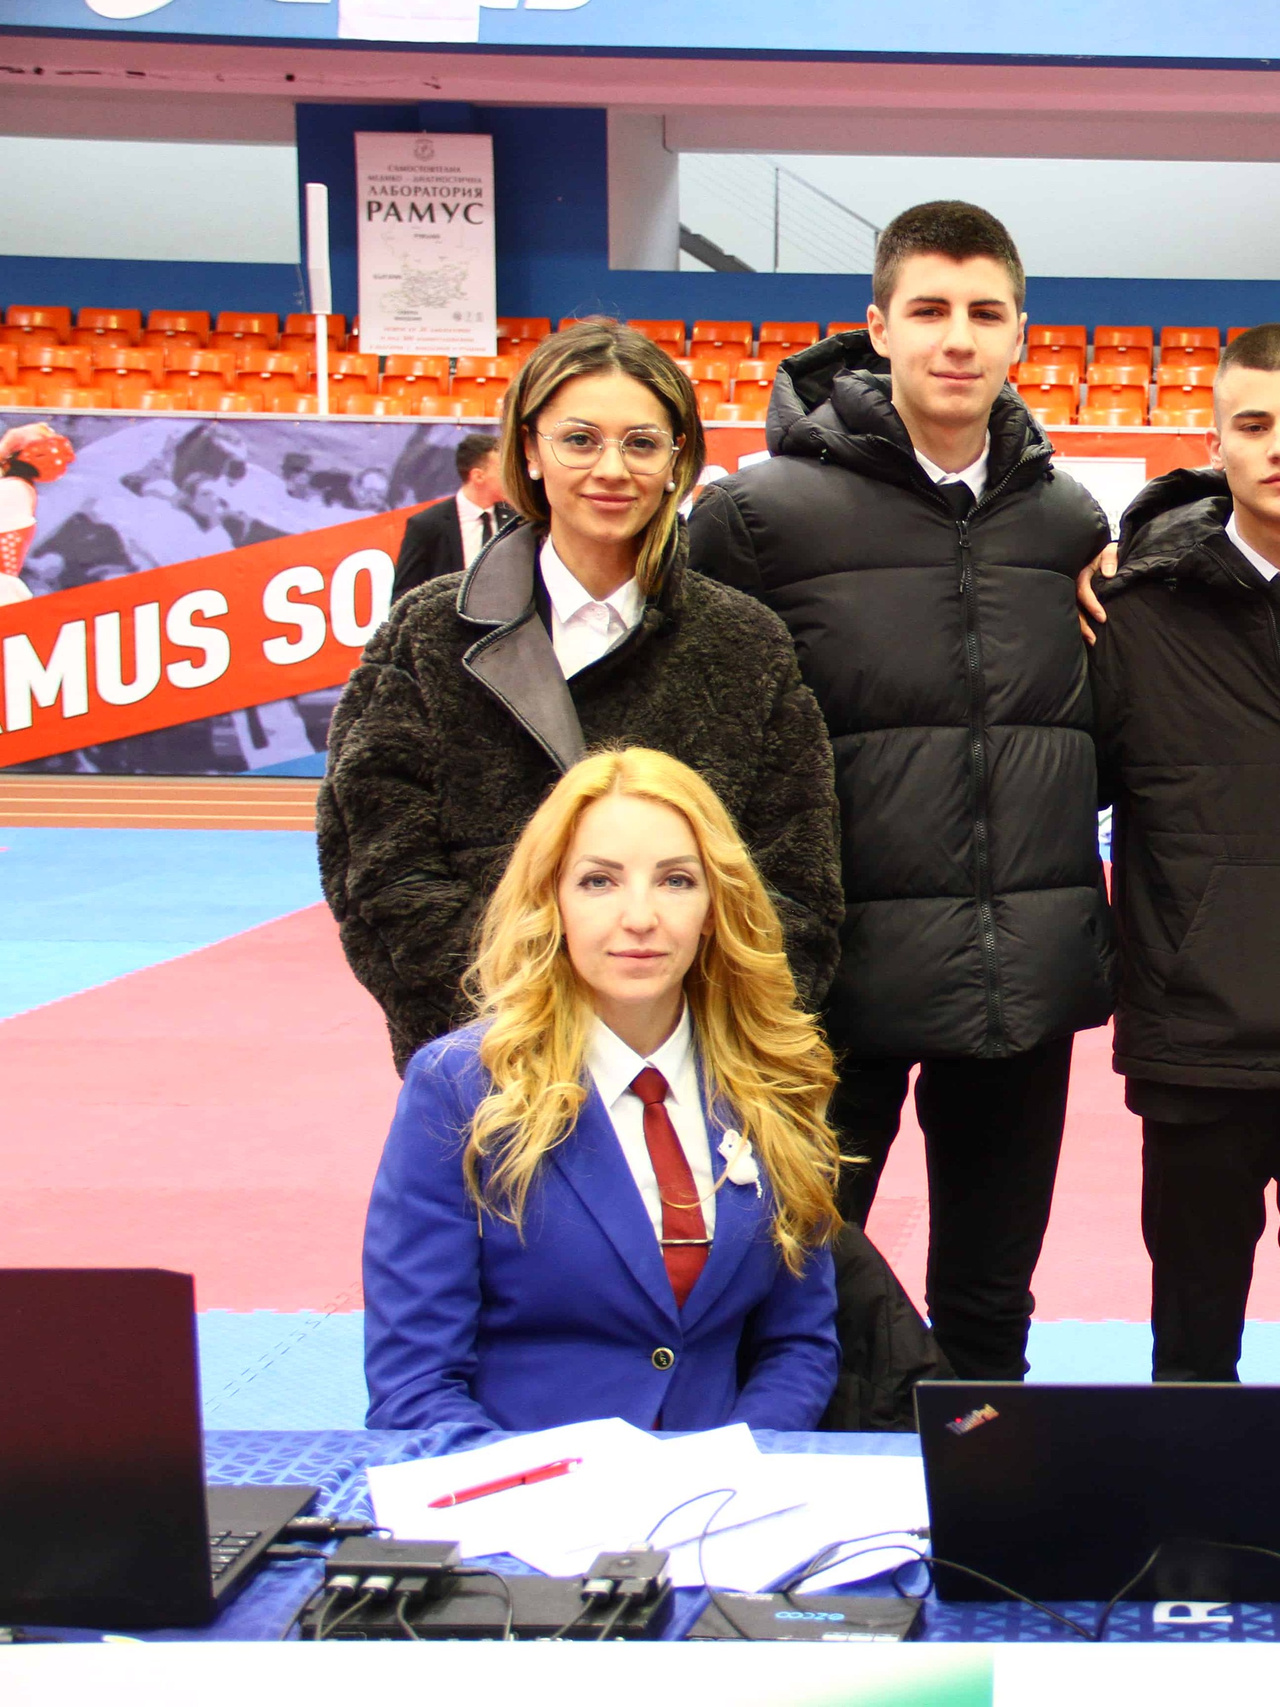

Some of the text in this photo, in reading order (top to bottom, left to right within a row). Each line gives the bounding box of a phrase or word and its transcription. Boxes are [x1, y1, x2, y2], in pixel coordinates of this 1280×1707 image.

[369, 185, 483, 198] ЛАБОРАТОРИЯ
[366, 200, 484, 225] РАМУС
[0, 548, 396, 732] MUS SO
